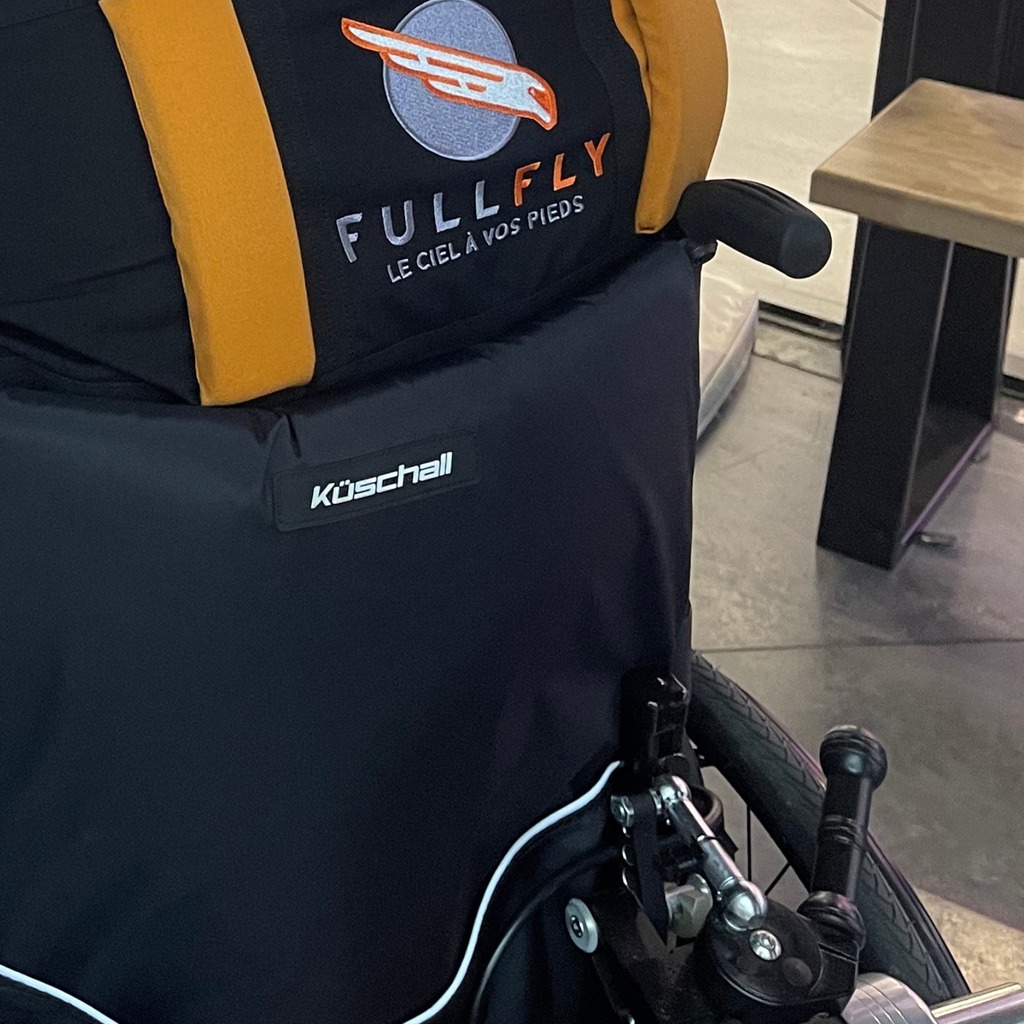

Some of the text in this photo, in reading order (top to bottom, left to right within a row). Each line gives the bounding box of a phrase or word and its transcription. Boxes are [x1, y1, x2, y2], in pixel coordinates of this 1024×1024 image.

[336, 133, 611, 263] FULLFLY
[387, 195, 585, 284] LE CIEL À VOS PIEDS
[310, 451, 453, 510] Küschall
